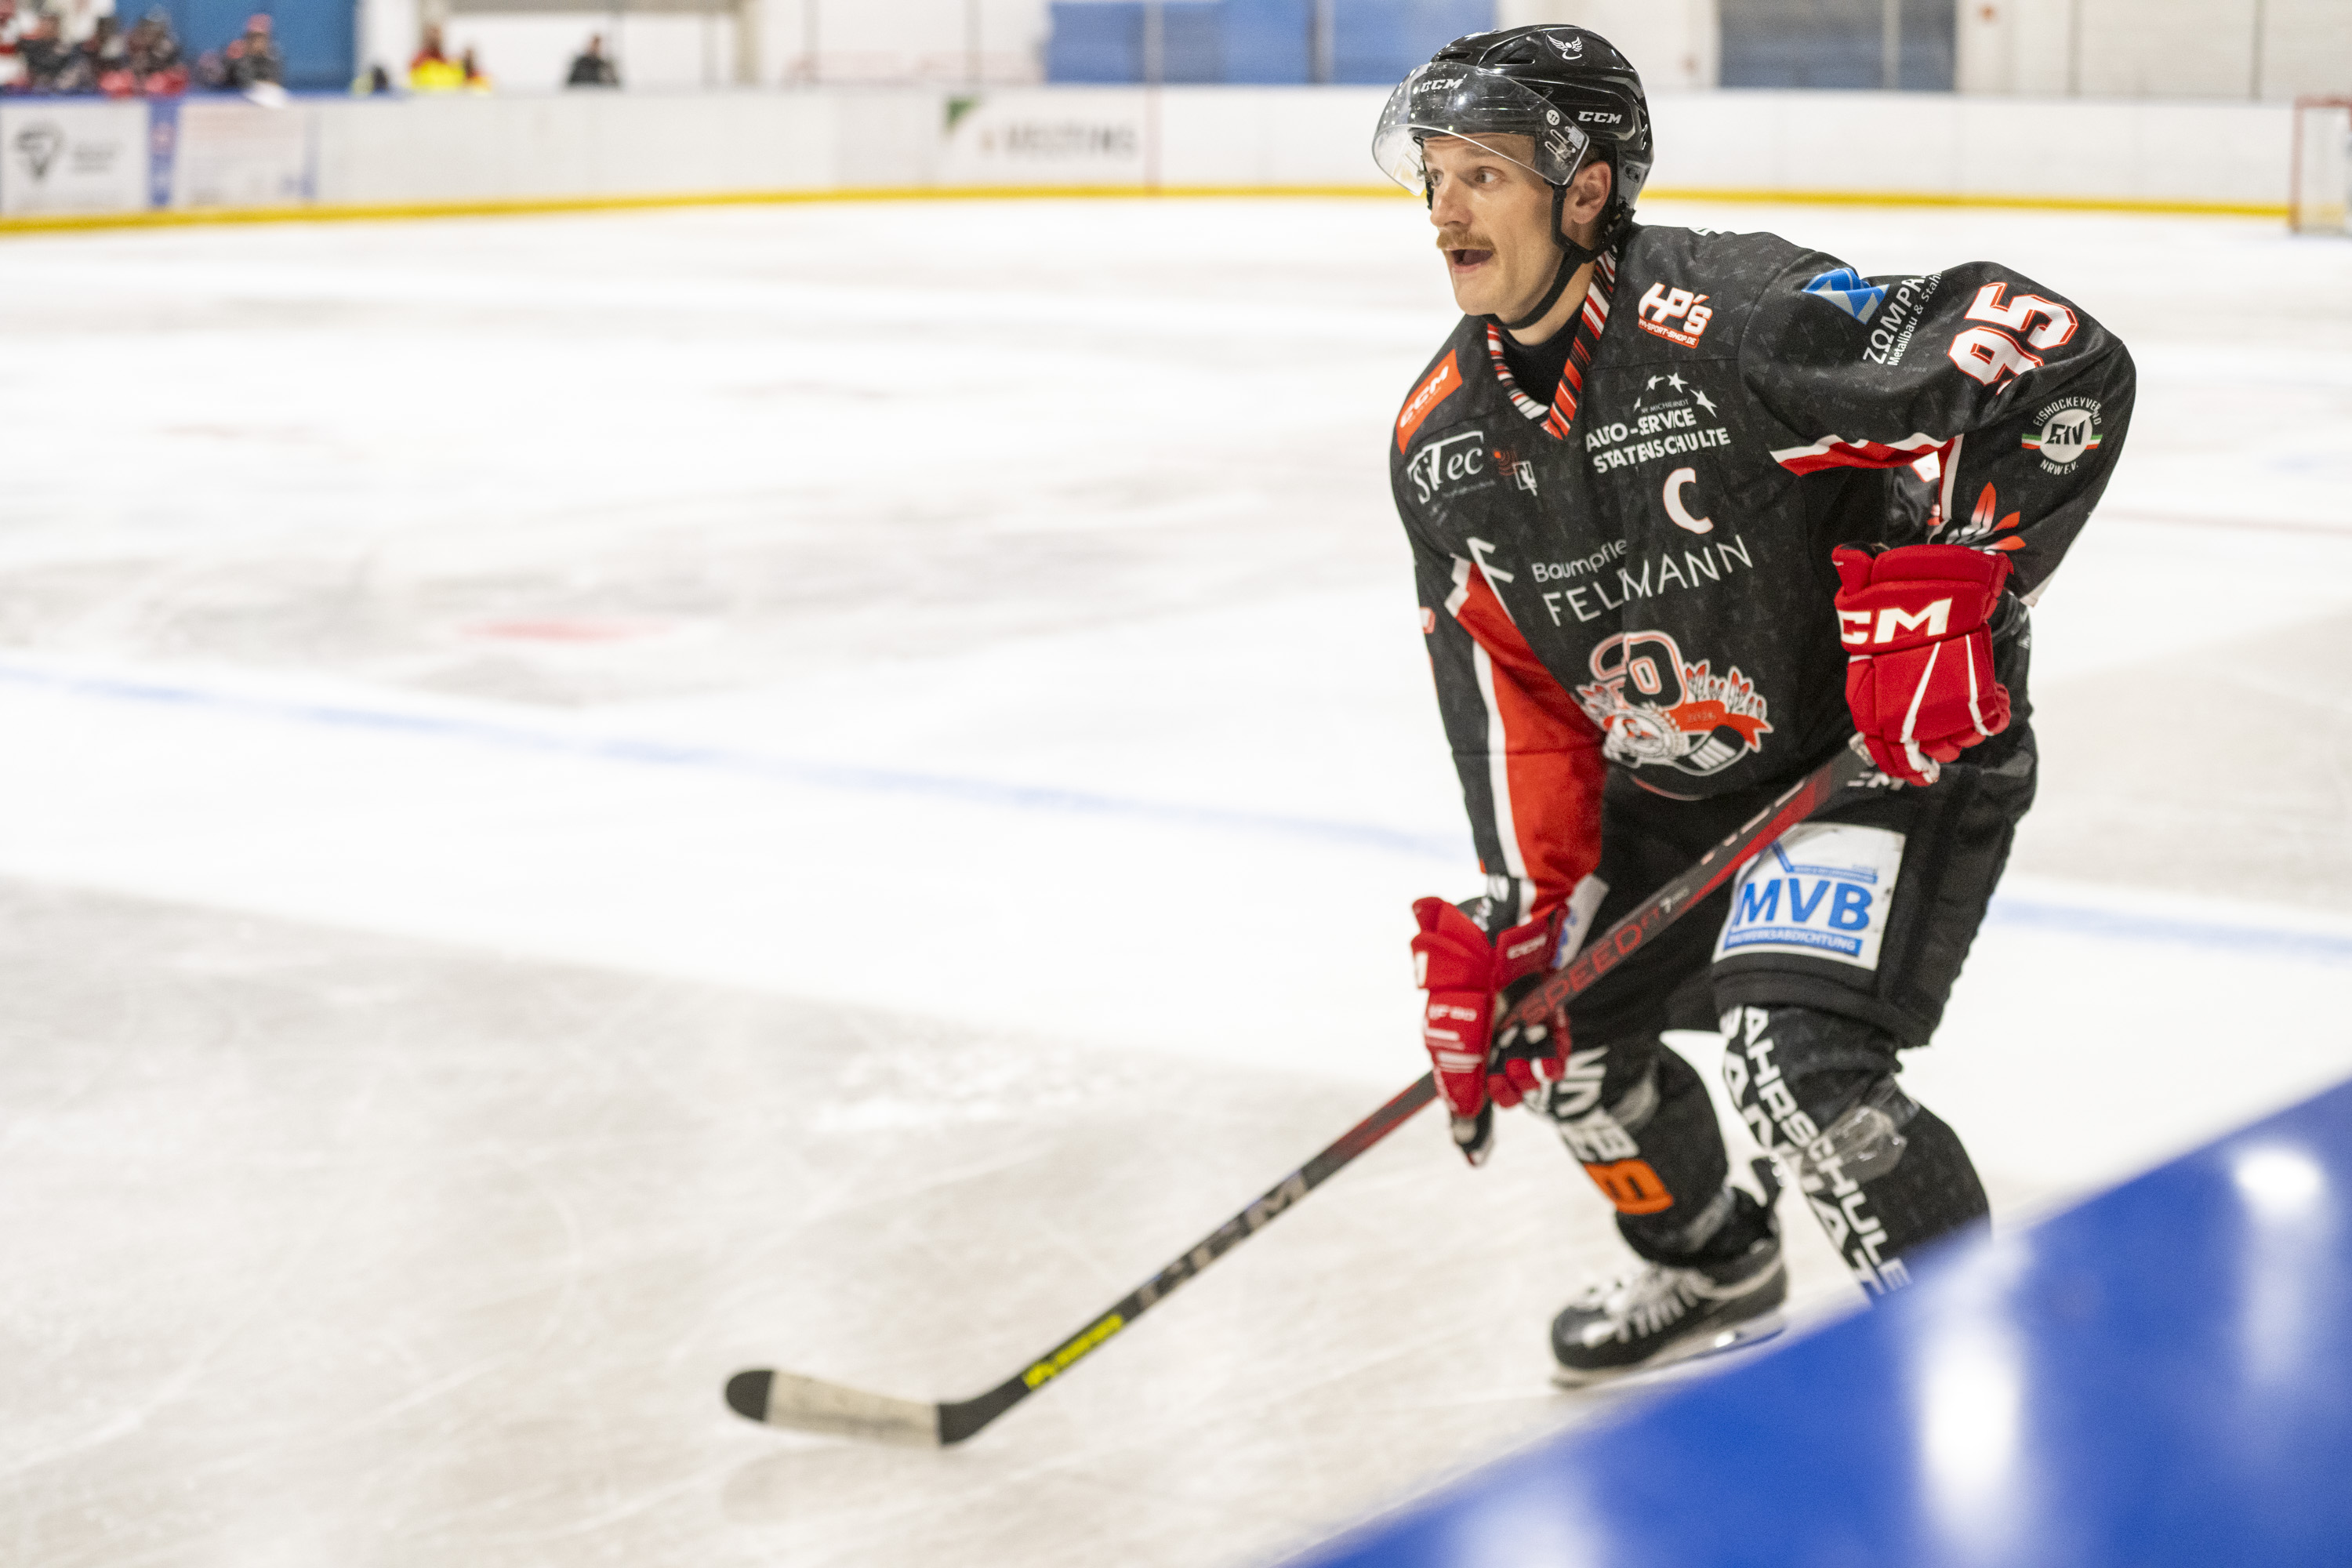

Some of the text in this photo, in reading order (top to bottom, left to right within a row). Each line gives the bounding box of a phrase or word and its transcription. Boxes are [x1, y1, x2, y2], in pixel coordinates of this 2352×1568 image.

[1420, 78, 1464, 93] CCM
[1577, 111, 1623, 124] CCM
[1886, 316, 1918, 366] Metallbau
[1913, 304, 1924, 314] &
[1947, 281, 2079, 396] 95
[1399, 365, 1449, 429] CCM
[1663, 466, 1714, 535] C
[1731, 877, 1873, 931] MVB
